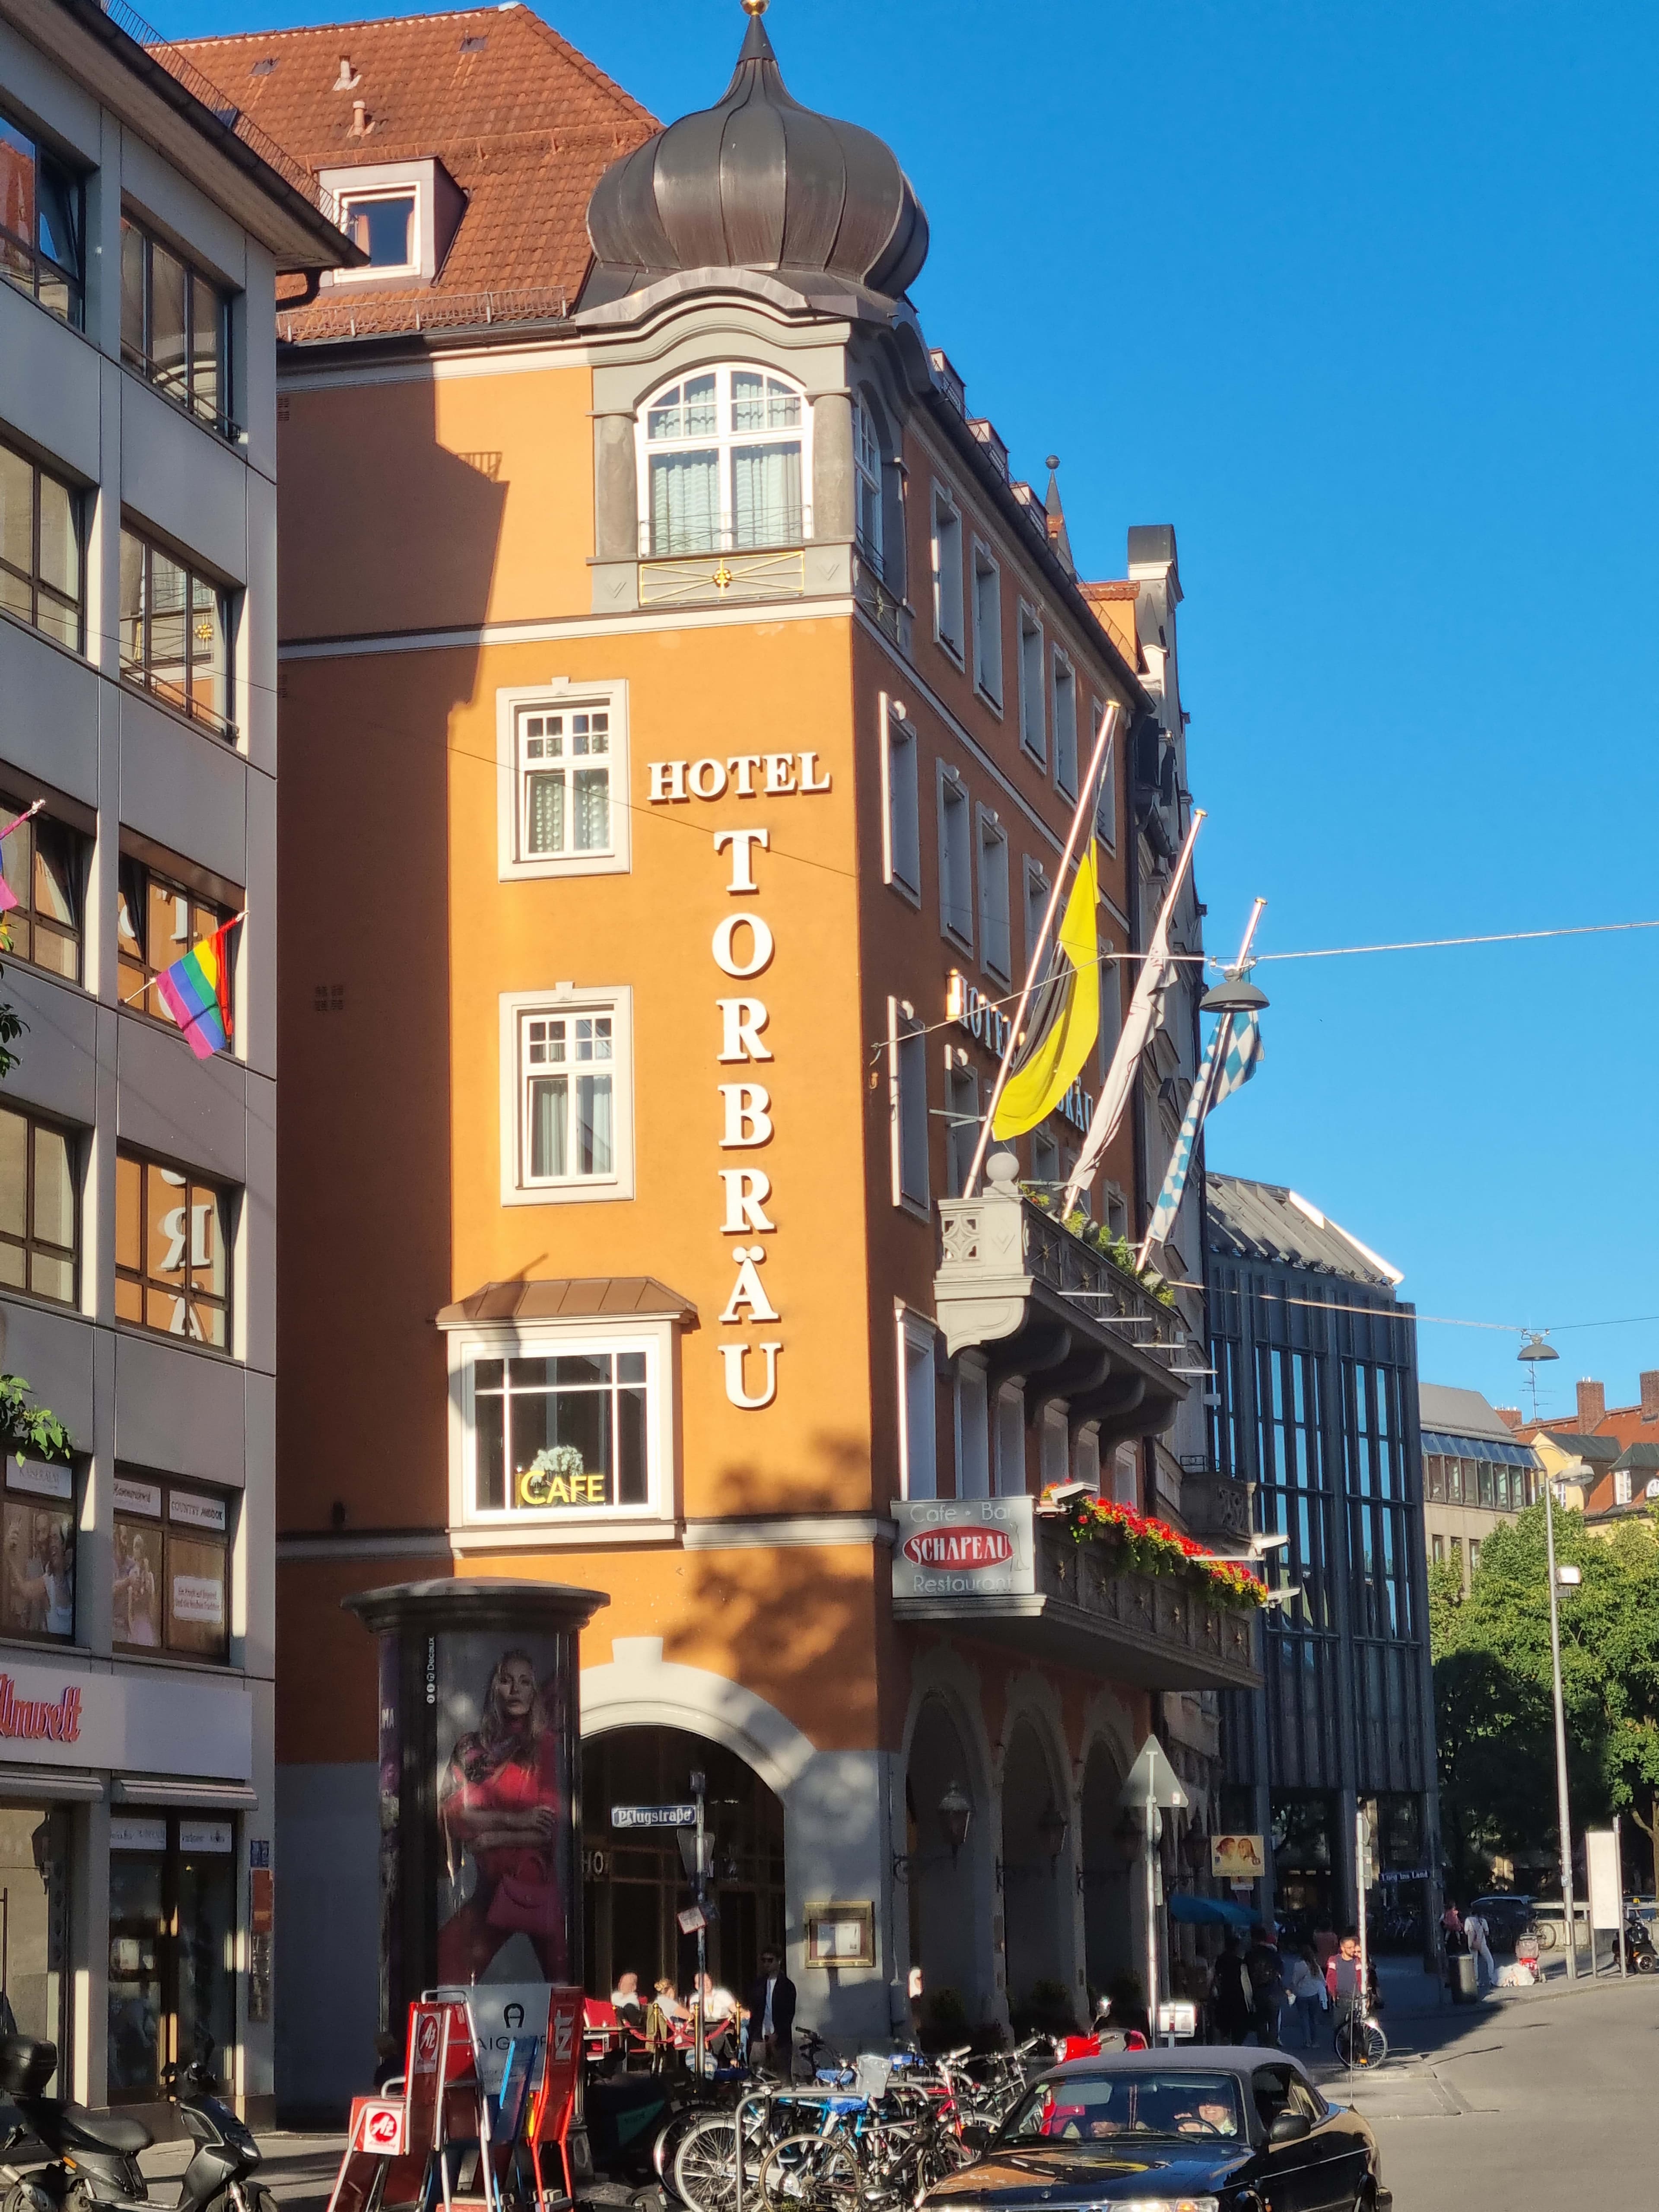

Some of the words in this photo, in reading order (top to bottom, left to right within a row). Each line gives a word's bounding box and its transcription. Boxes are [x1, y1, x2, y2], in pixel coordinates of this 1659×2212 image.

[647, 752, 830, 801] HOTEL
[712, 829, 782, 1408] TORBRÄU
[521, 1471, 605, 1504] CAFE
[910, 1504, 957, 1523] Cafe
[981, 1502, 1011, 1521] Bar
[910, 1535, 1009, 1565] SCHAPEAU
[913, 1575, 1014, 1593] Restaurant
[618, 1807, 692, 1825] Pflugstraße
